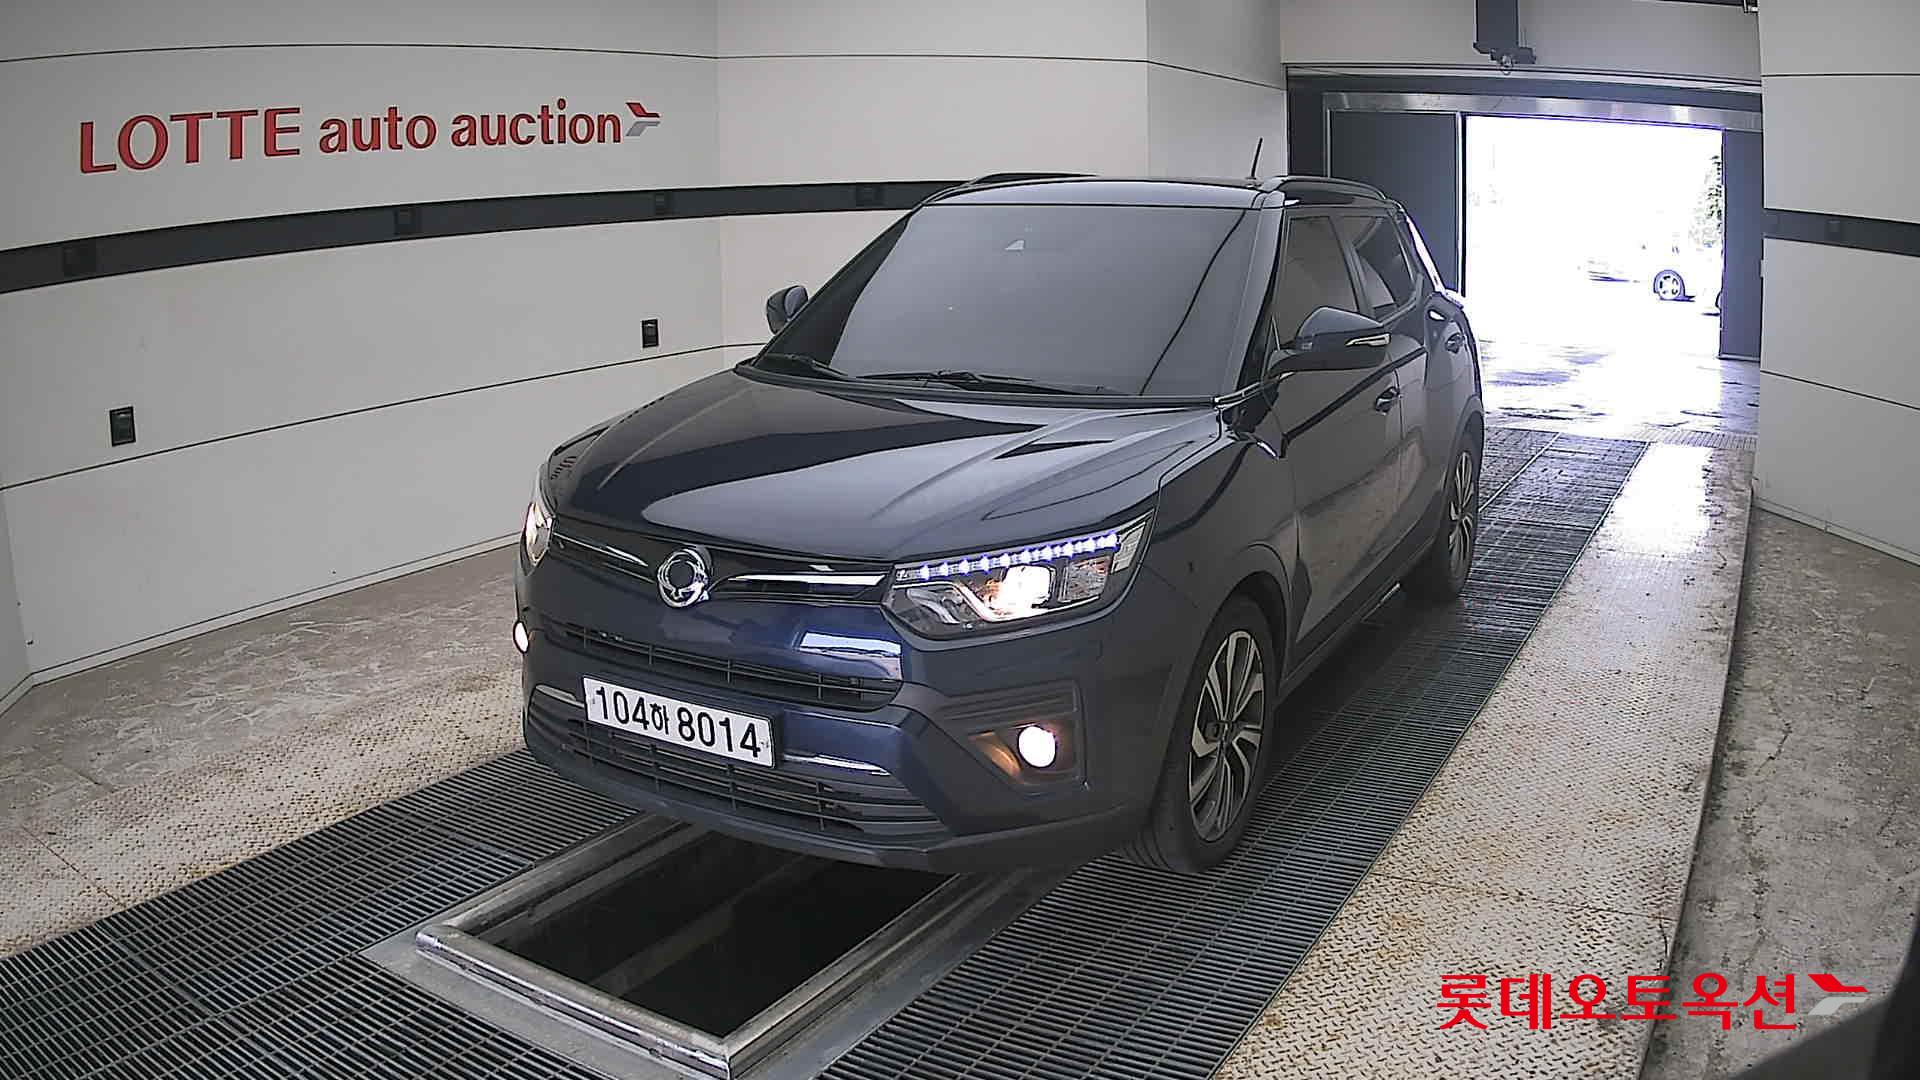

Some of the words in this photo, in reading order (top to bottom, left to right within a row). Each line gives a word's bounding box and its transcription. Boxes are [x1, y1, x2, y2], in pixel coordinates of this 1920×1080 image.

[80, 107, 300, 173] LOTTE
[319, 106, 438, 154] auto
[450, 98, 622, 147] auction
